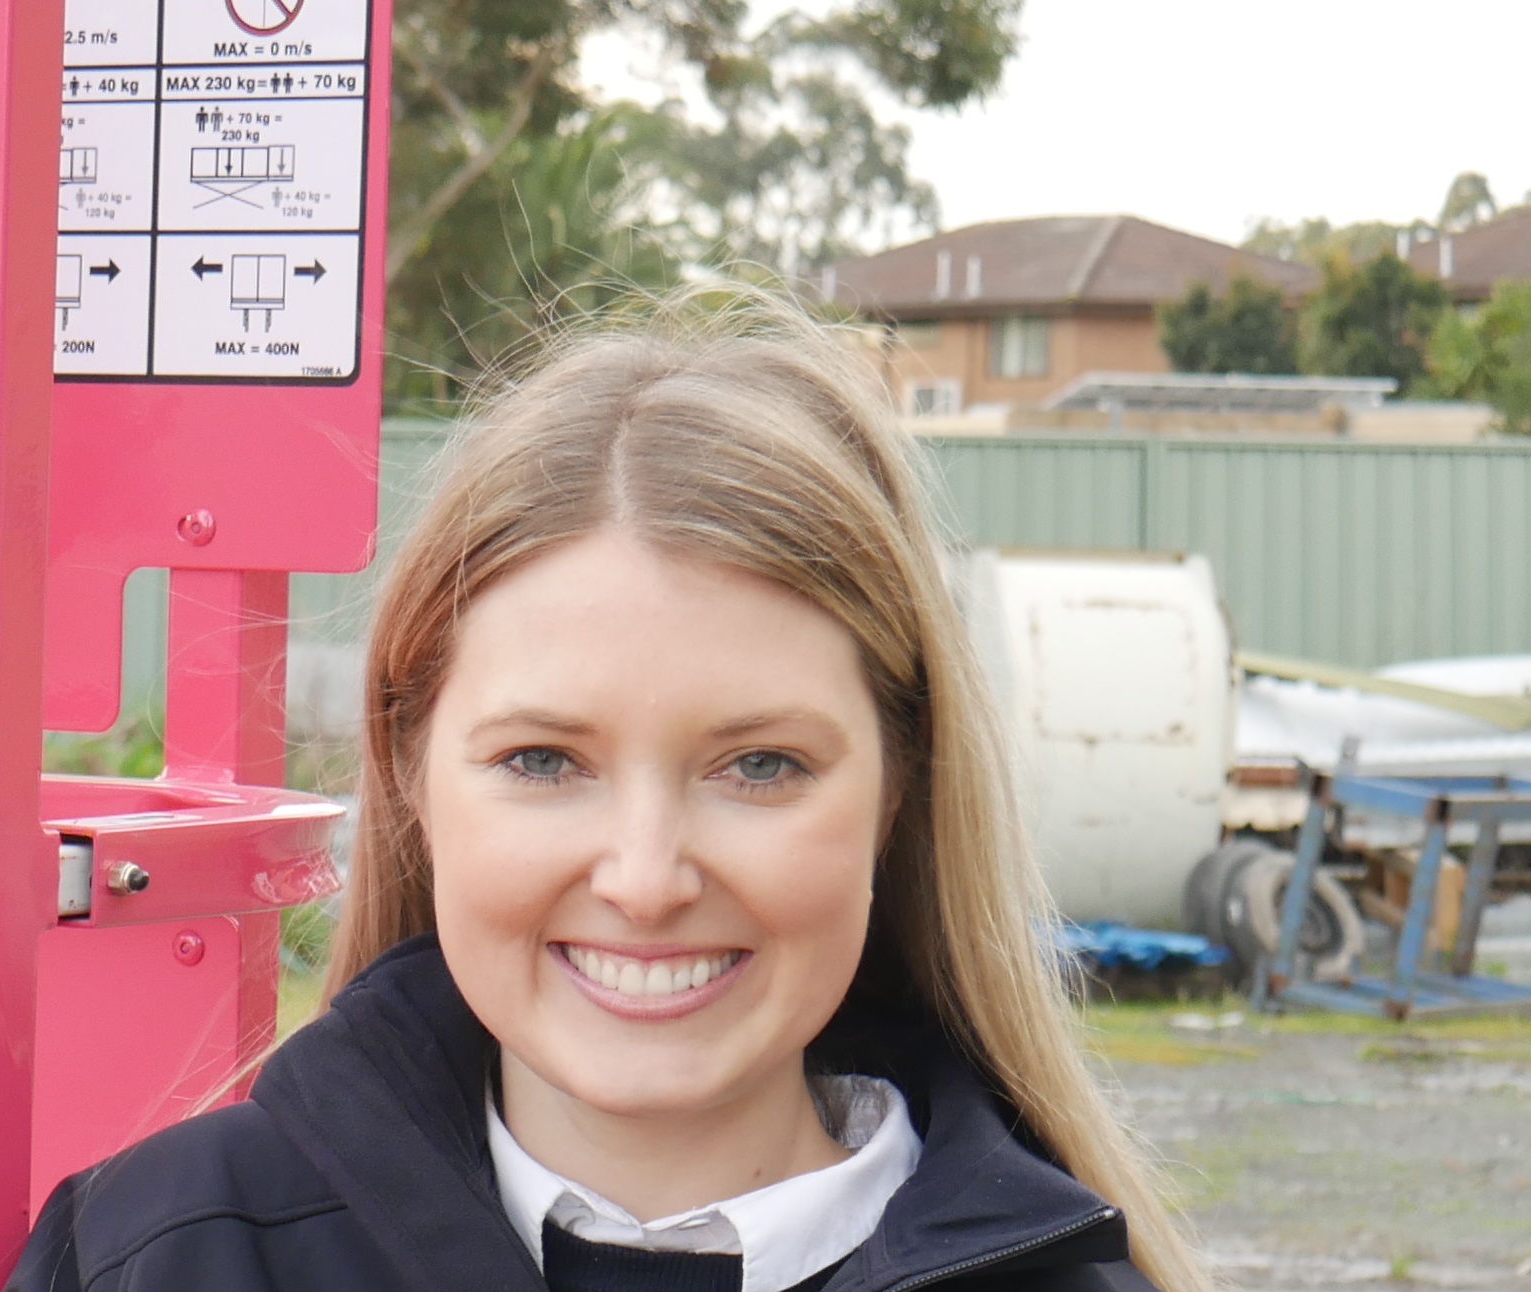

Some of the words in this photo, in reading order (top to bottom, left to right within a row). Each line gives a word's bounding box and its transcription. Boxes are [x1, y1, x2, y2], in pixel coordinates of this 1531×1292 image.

[64, 31, 86, 44] 2.5
[90, 29, 118, 45] m/s
[214, 42, 248, 57] MAX
[270, 42, 279, 56] 0
[285, 40, 312, 57] m/s
[98, 79, 116, 92] 40
[121, 78, 139, 95] kg
[166, 77, 200, 92] MAX
[205, 77, 232, 90] 230
[314, 75, 332, 88] 70
[337, 74, 356, 92] kg
[239, 113, 252, 124] 70
[256, 112, 270, 126] kg
[221, 130, 242, 141] 230
[246, 130, 260, 143] kg
[111, 193, 122, 205] kg
[294, 191, 306, 201] 40
[309, 191, 321, 203] kg
[104, 208, 115, 219] kg
[299, 206, 313, 218] kg
[62, 341, 95, 354] 200N
[215, 342, 246, 355] MAX
[264, 342, 300, 355] 400N
